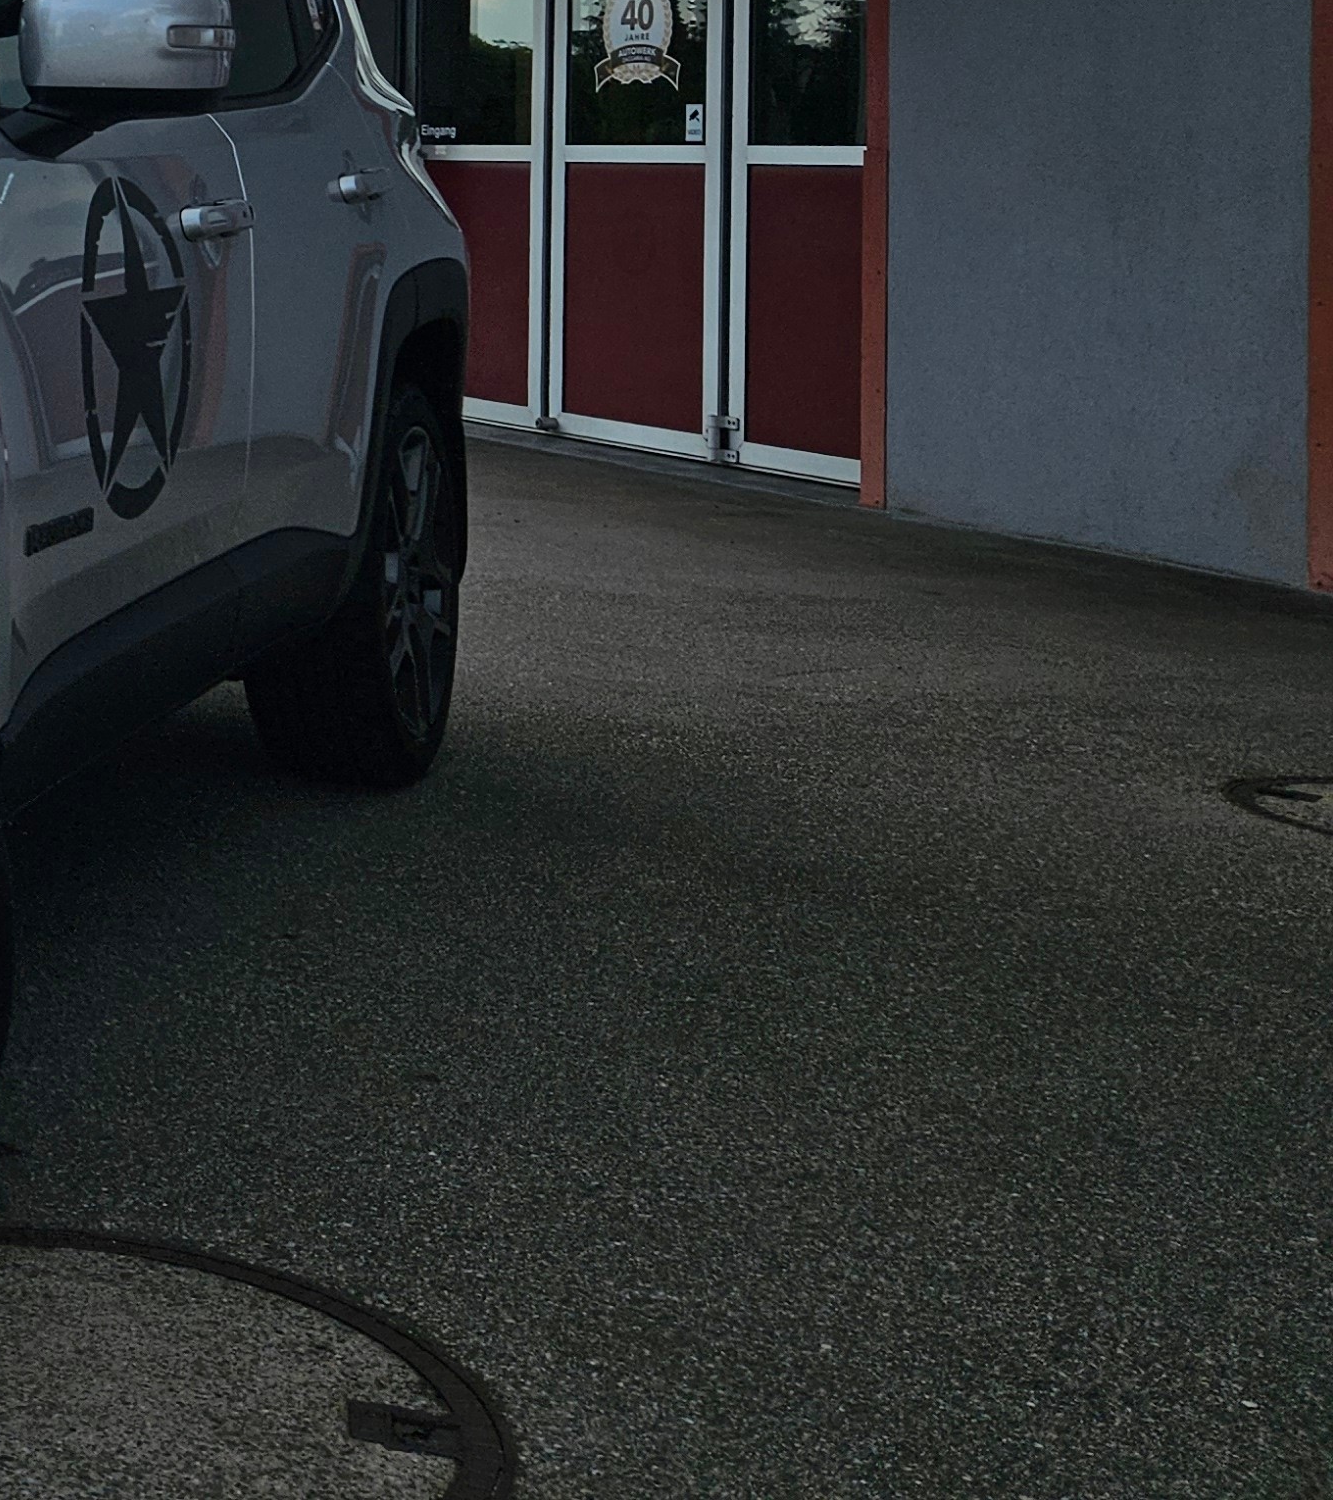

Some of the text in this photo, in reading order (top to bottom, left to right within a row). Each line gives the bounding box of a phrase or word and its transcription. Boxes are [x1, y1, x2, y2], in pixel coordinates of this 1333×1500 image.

[625, 32, 650, 42] JAHRE
[618, 46, 656, 57] AUTOWERK
[421, 124, 456, 139] Eingang
